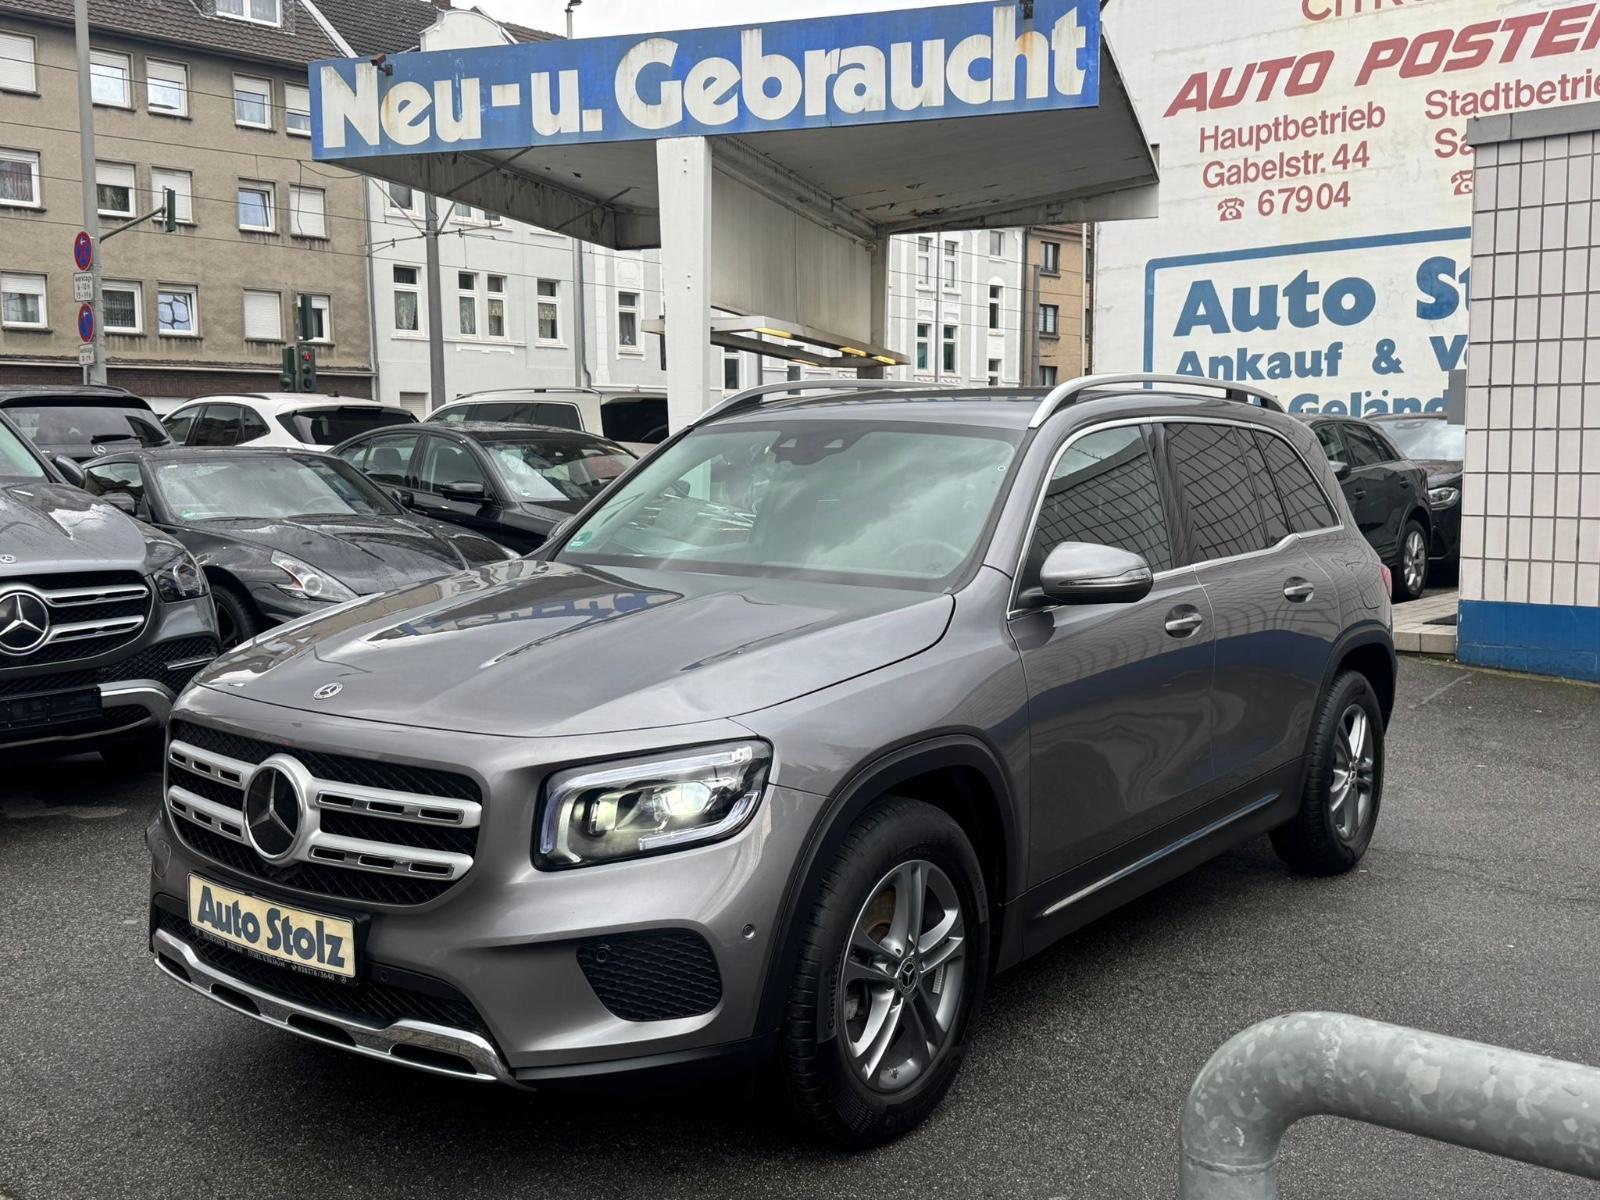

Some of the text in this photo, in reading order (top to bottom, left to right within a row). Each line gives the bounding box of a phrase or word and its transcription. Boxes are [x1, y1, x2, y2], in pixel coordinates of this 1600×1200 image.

[614, 5, 1087, 130] Gebraucht
[1163, 50, 1335, 118] AUTO
[1199, 101, 1386, 153] Hauptbetrieb
[1202, 140, 1370, 189] Gabelstr. 44
[1257, 180, 1352, 217] 67904
[1173, 269, 1376, 337] Auto
[1176, 341, 1343, 381] Ankauf
[1372, 338, 1405, 375] &
[197, 885, 346, 969] Auto Stolz
